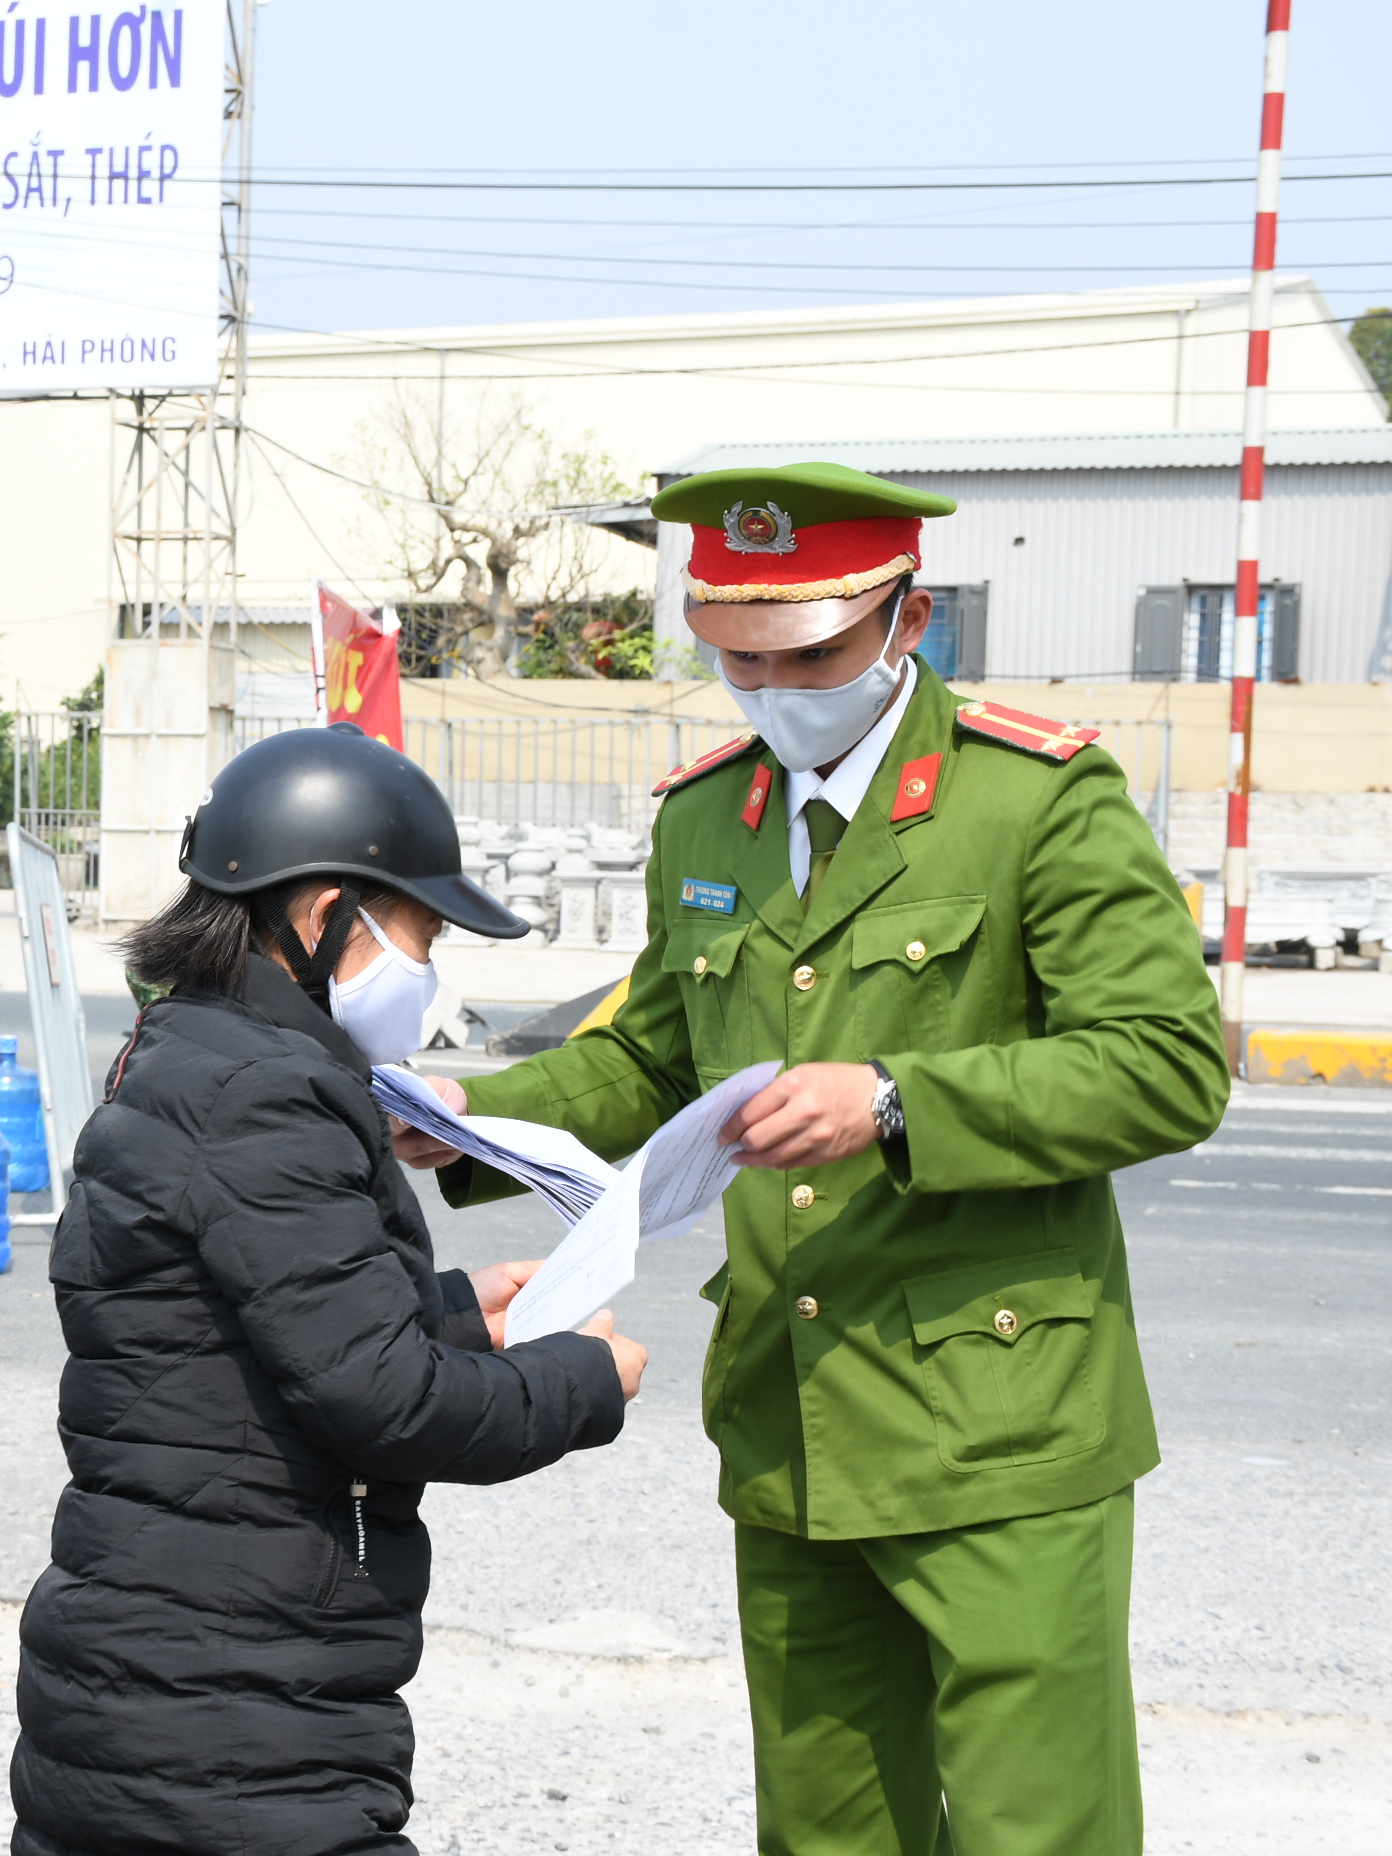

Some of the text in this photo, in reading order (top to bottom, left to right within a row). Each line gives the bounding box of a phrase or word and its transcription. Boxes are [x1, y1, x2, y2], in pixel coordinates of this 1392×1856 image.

[67, 3, 184, 94] HƠN
[2, 131, 71, 217] SẮT,
[85, 132, 179, 205] THÉP
[21, 332, 67, 366] HẢI
[80, 331, 177, 364] PHÒNG
